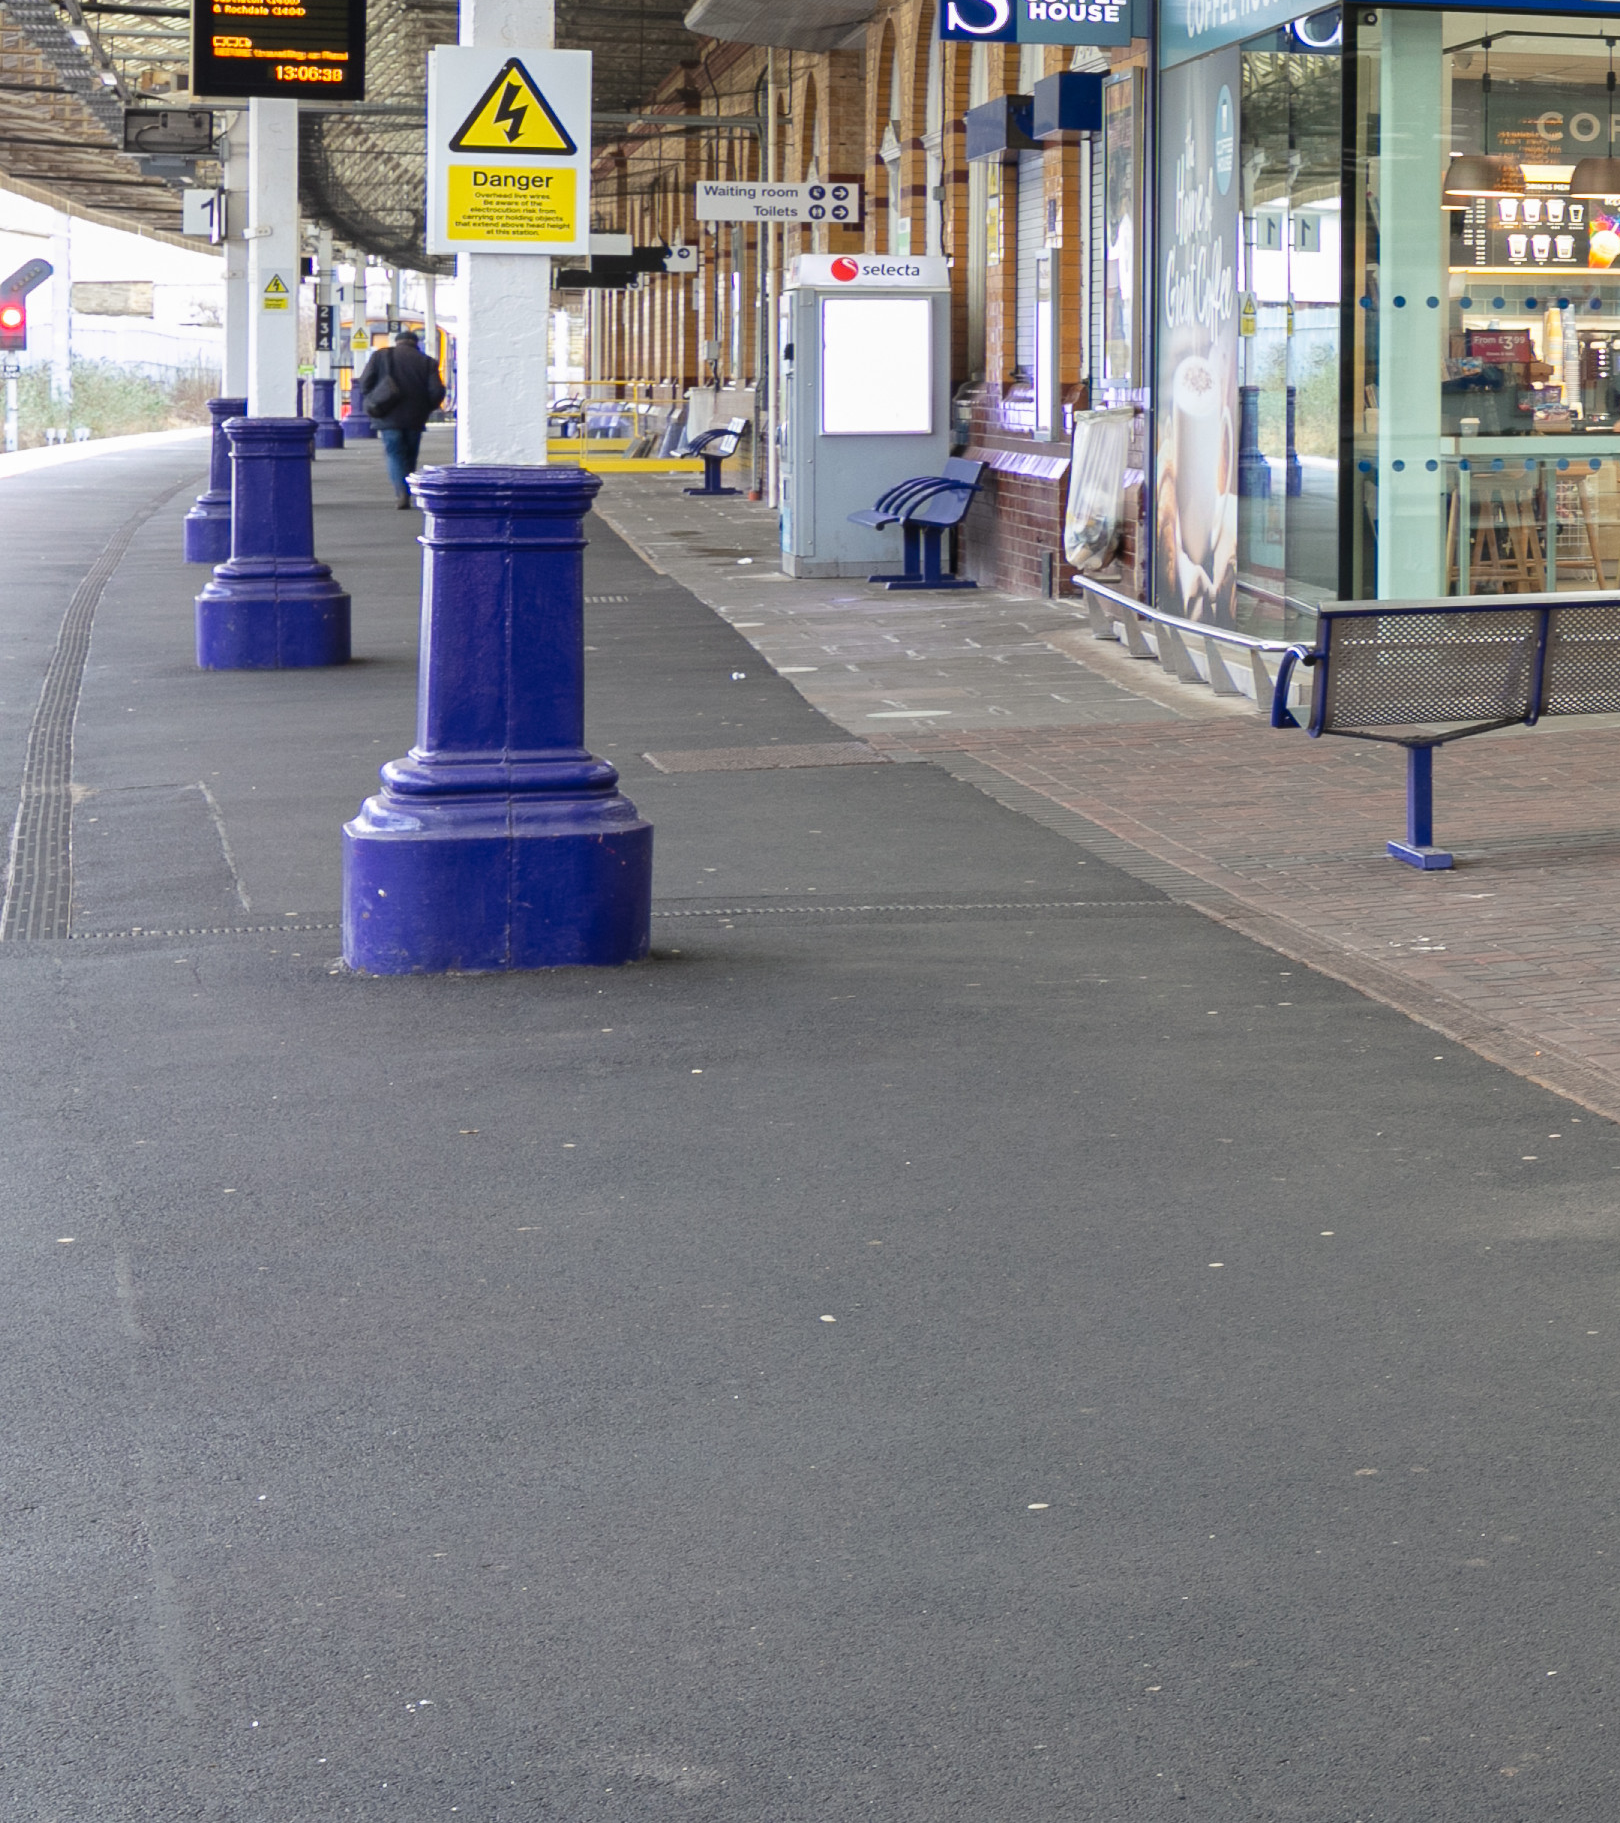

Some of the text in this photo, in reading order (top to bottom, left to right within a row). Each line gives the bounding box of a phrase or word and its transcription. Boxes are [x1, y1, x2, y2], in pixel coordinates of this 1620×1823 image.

[224, 5, 268, 15] Rochdale
[1028, 2, 1120, 22] HOUSE
[276, 66, 342, 82] 13:06:38
[473, 171, 554, 190] Danger
[704, 186, 798, 199] Waiting room
[201, 197, 214, 228] 1
[754, 206, 798, 217] Toilets
[862, 264, 920, 276] selecta
[336, 287, 344, 301] 1
[1166, 235, 1233, 347] Great Coffee
[320, 307, 328, 318] 2
[320, 323, 328, 333] 3
[320, 337, 330, 348] 4
[1473, 336, 1496, 344] From
